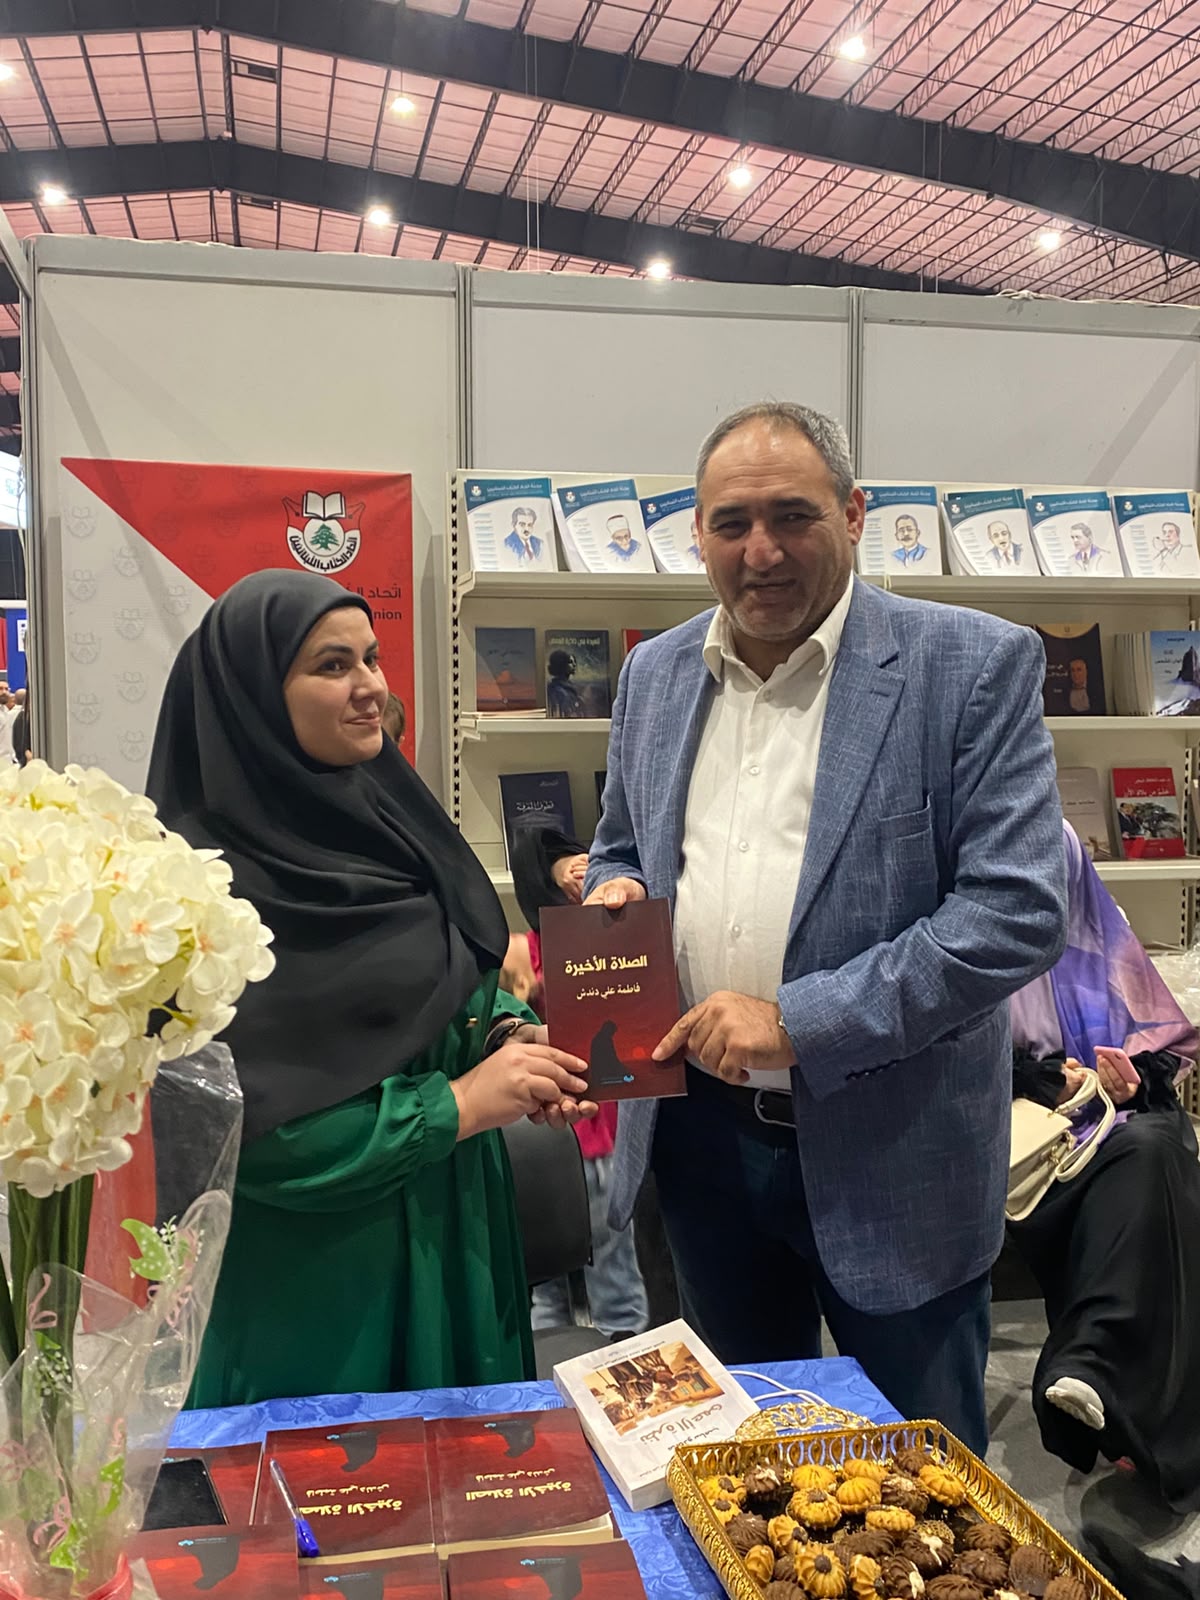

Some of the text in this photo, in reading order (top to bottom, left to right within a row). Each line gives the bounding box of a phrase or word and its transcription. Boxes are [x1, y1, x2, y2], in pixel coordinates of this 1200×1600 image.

[373, 608, 402, 620] nion
[564, 954, 648, 977] الصلاة الأخيرة
[576, 982, 641, 1000] فاطمة علي دندش
[639, 1421, 677, 1446] نظرة
[475, 1467, 556, 1482] فاطمة علي دندش
[305, 1482, 390, 1498] فاطمة علي دندش
[465, 1480, 572, 1501] الصلاة الأخيرة
[347, 1498, 402, 1514] الأخيرة
